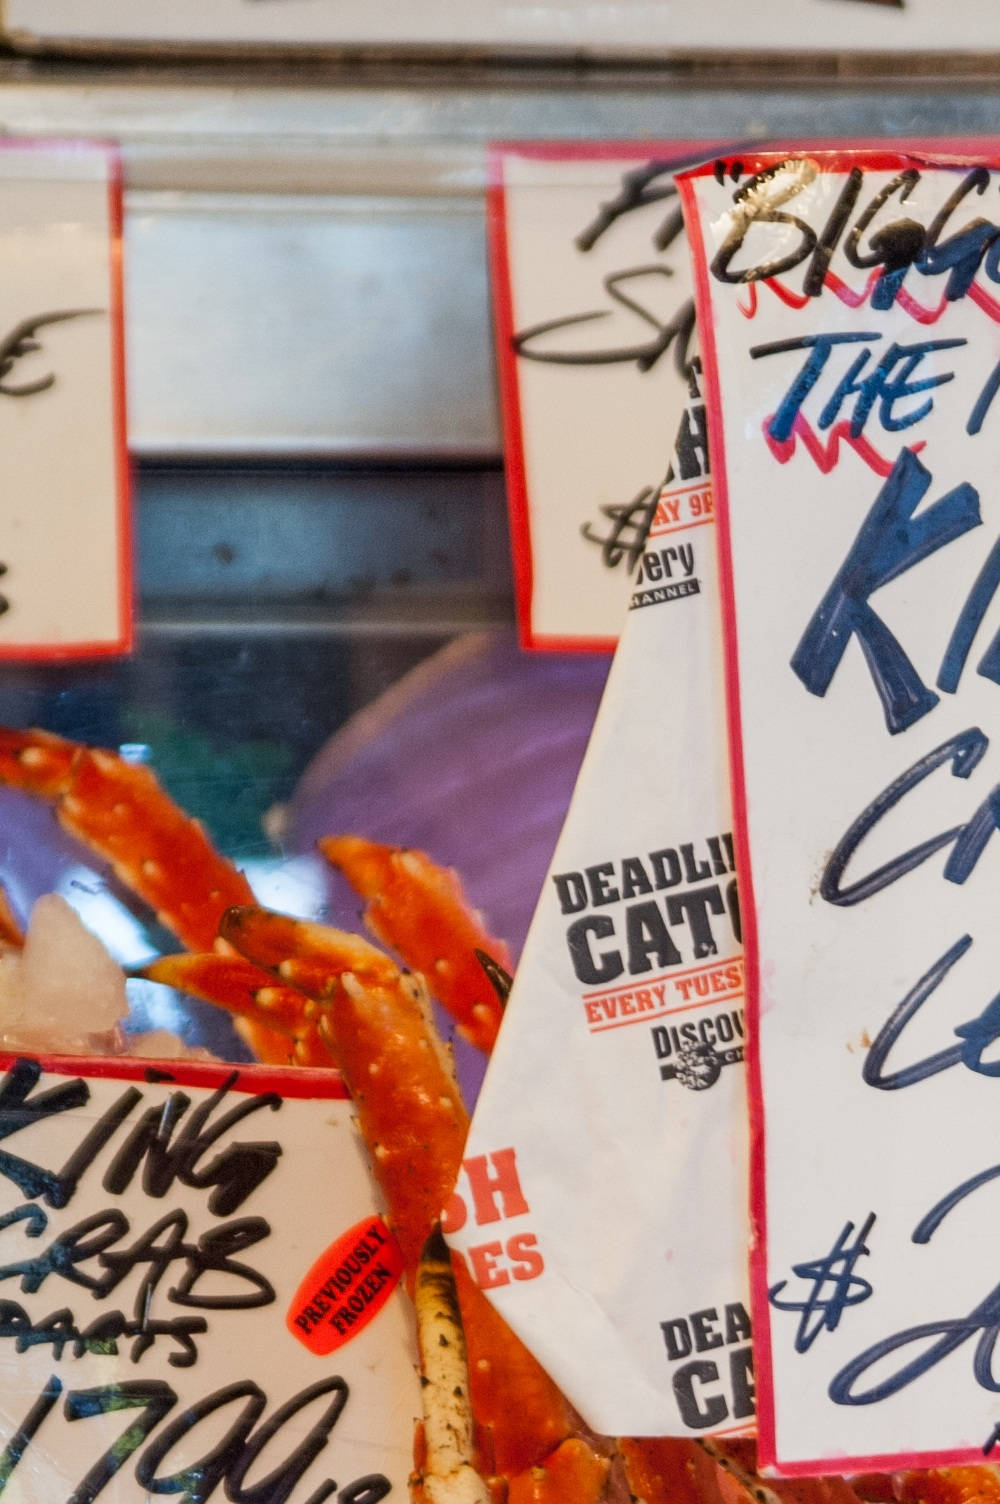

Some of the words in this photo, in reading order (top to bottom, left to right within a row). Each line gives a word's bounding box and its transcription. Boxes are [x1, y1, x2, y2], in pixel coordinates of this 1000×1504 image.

[750, 330, 967, 443] THE
[584, 984, 666, 1025] EVERY
[294, 1223, 388, 1336] PREVIOUSLY
[328, 1262, 393, 1336] FROZEN
